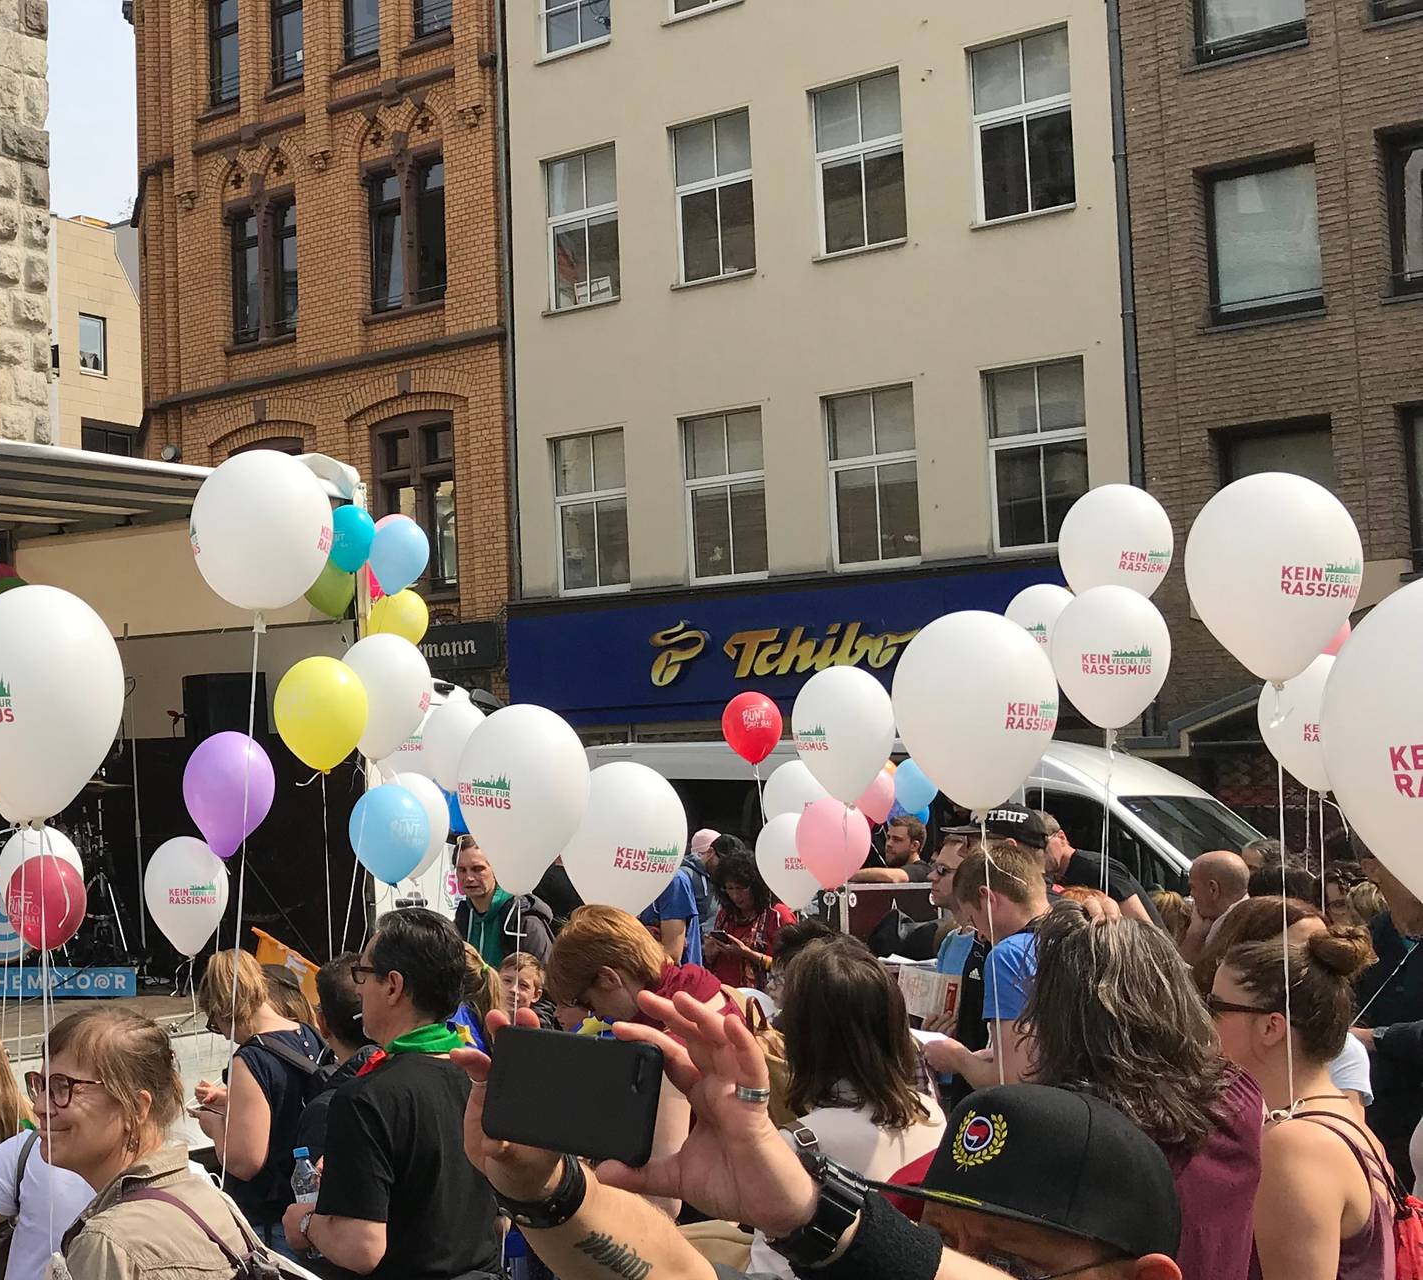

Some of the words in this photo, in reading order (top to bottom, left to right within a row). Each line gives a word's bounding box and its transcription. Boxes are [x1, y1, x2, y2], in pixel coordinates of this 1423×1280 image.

[1120, 551, 1147, 562] KEIN
[1281, 565, 1323, 581] KEIN
[419, 639, 477, 658] mann
[723, 621, 921, 678] Tchibo
[1081, 653, 1111, 664] KEIN
[1081, 664, 1152, 675] RASSISMUS
[1007, 702, 1038, 717] KEIN
[1005, 717, 1055, 731] RASSISM
[1303, 723, 1320, 733] KE
[1389, 744, 1423, 771] KE
[617, 847, 646, 860] KEIN
[614, 858, 676, 873] RASSISMUS
[168, 888, 189, 896] KEIN
[169, 896, 217, 905] RASSISMUS
